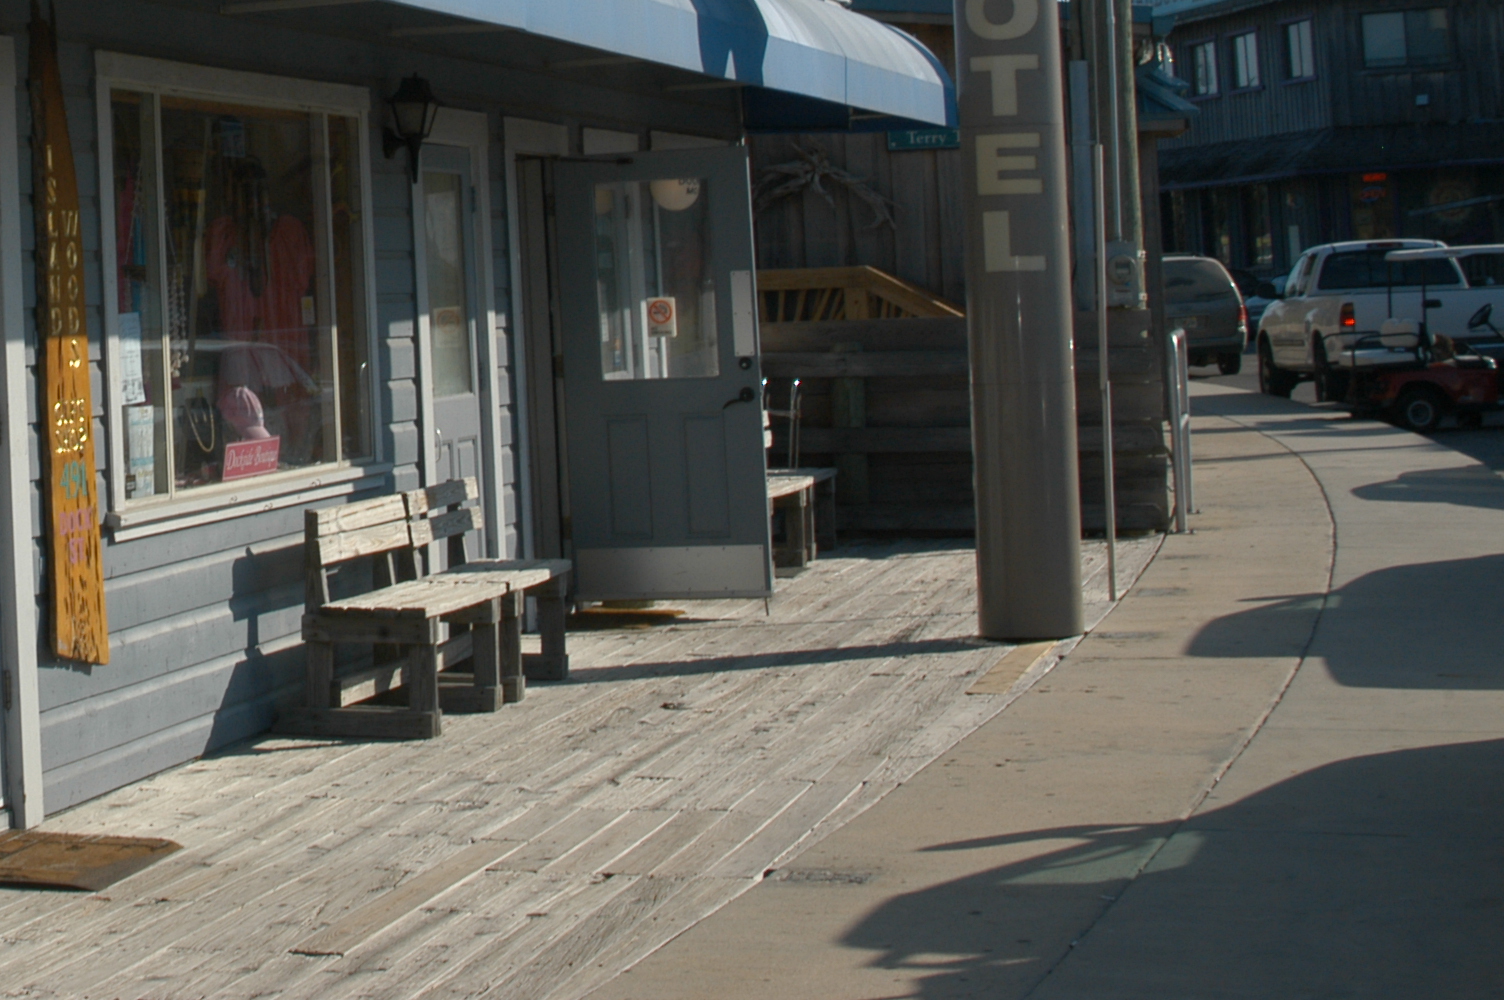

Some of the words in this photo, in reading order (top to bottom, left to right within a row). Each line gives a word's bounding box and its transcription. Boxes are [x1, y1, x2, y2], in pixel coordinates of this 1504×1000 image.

[906, 130, 947, 146] Terry
[47, 145, 63, 336] ISLAND
[61, 210, 81, 369] WOODS
[60, 461, 88, 500] 491
[59, 506, 94, 536] DOCK
